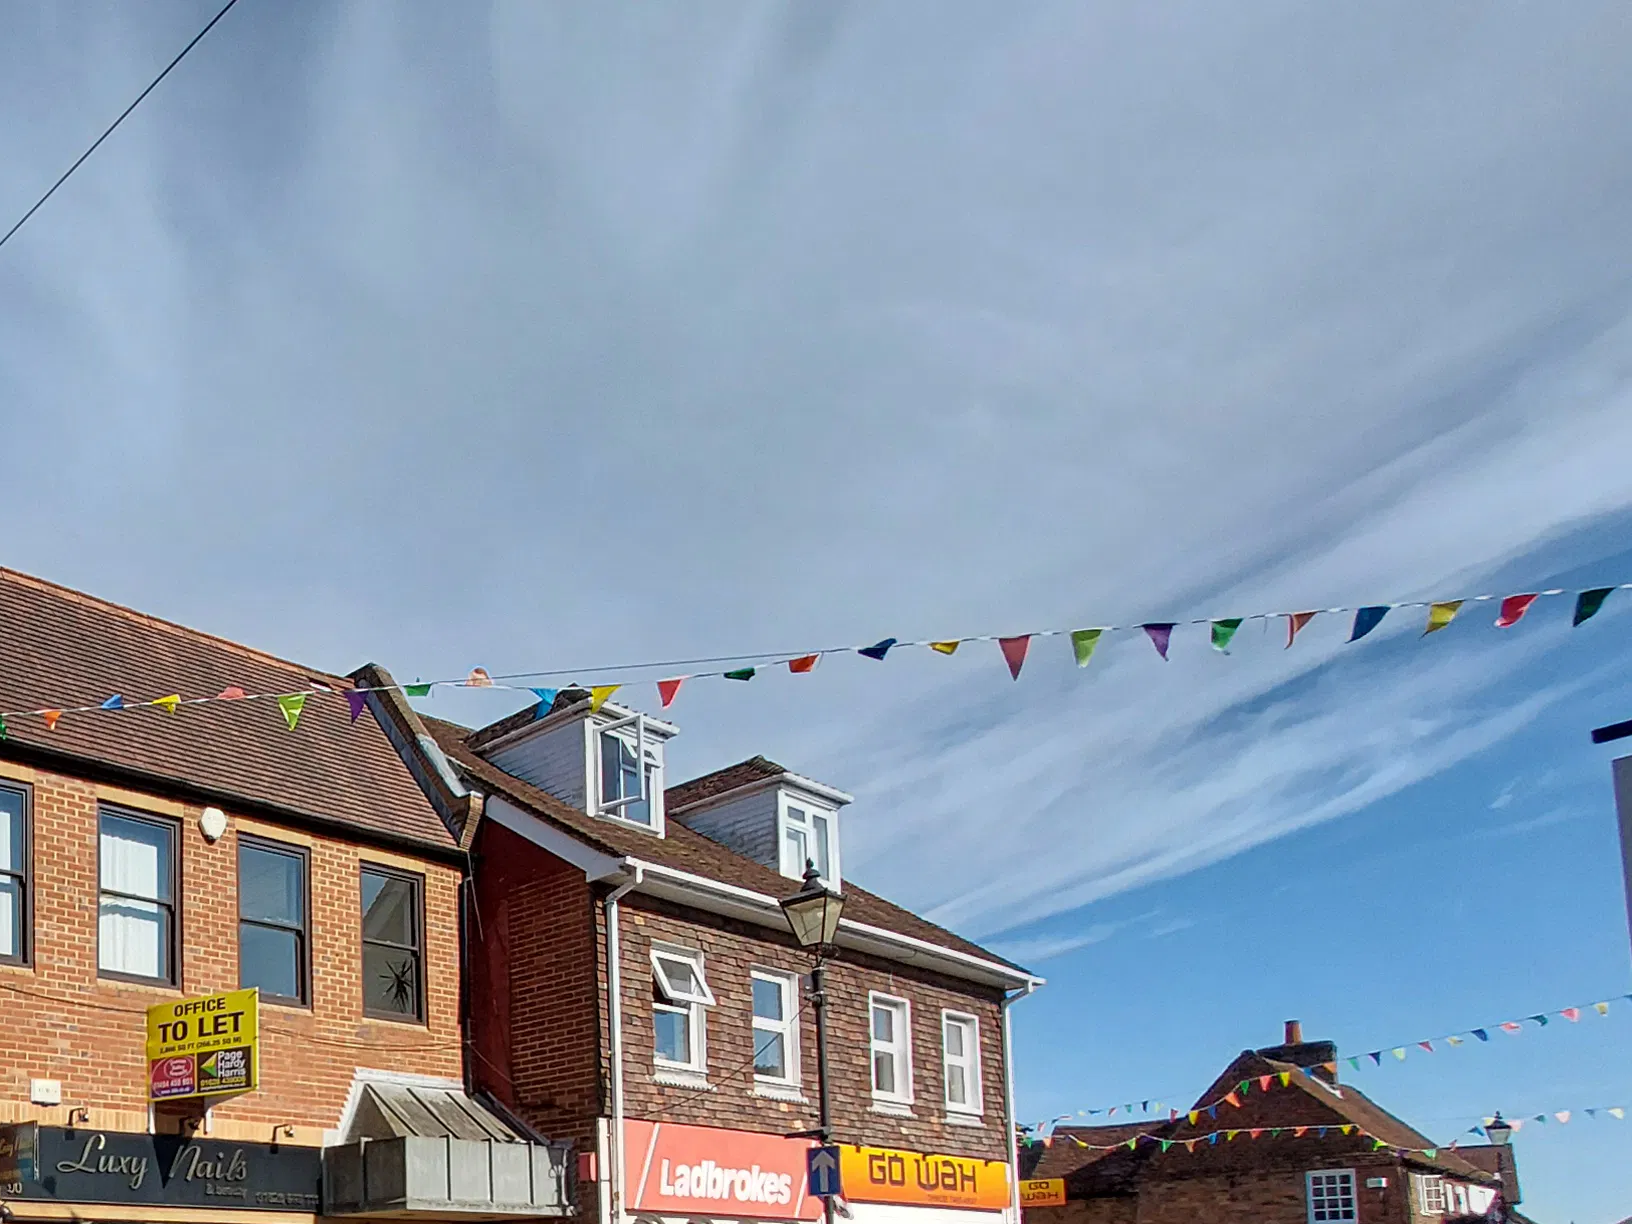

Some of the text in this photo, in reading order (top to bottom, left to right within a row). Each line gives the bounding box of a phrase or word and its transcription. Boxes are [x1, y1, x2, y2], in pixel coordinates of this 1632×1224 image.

[174, 997, 226, 1017] OFFICE
[158, 1011, 244, 1043] TO LET
[218, 1051, 243, 1061] Page
[218, 1059, 246, 1069] Hardy
[218, 1068, 246, 1078] Harris
[56, 1133, 248, 1190] Luxy Nails
[660, 1158, 792, 1205] Ladbrokes
